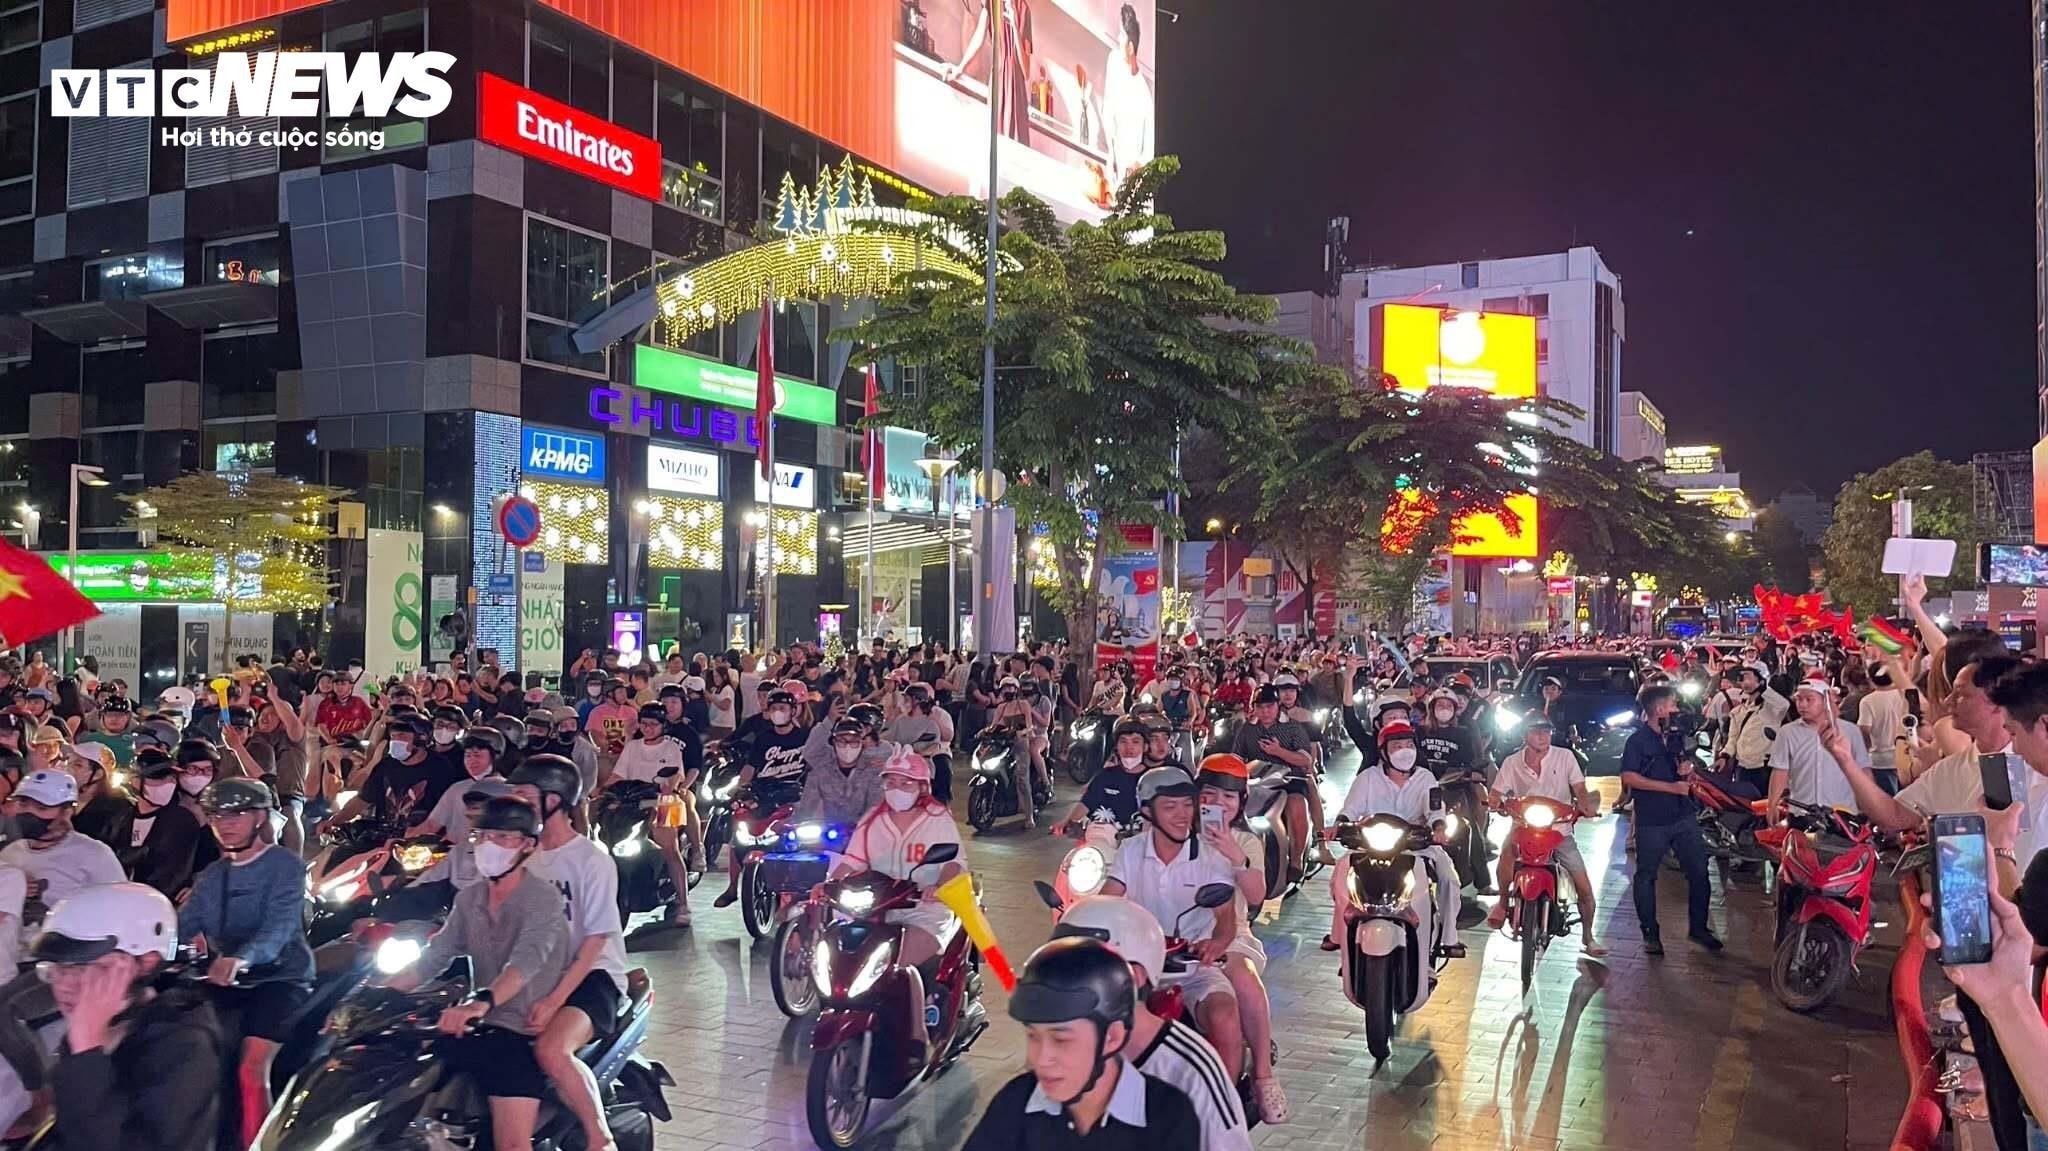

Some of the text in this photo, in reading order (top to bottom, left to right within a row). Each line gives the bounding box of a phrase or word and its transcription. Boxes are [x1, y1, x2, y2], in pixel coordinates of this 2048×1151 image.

[517, 100, 634, 176] Emirates
[529, 446, 592, 474] KPMG
[906, 842, 926, 864] 18
